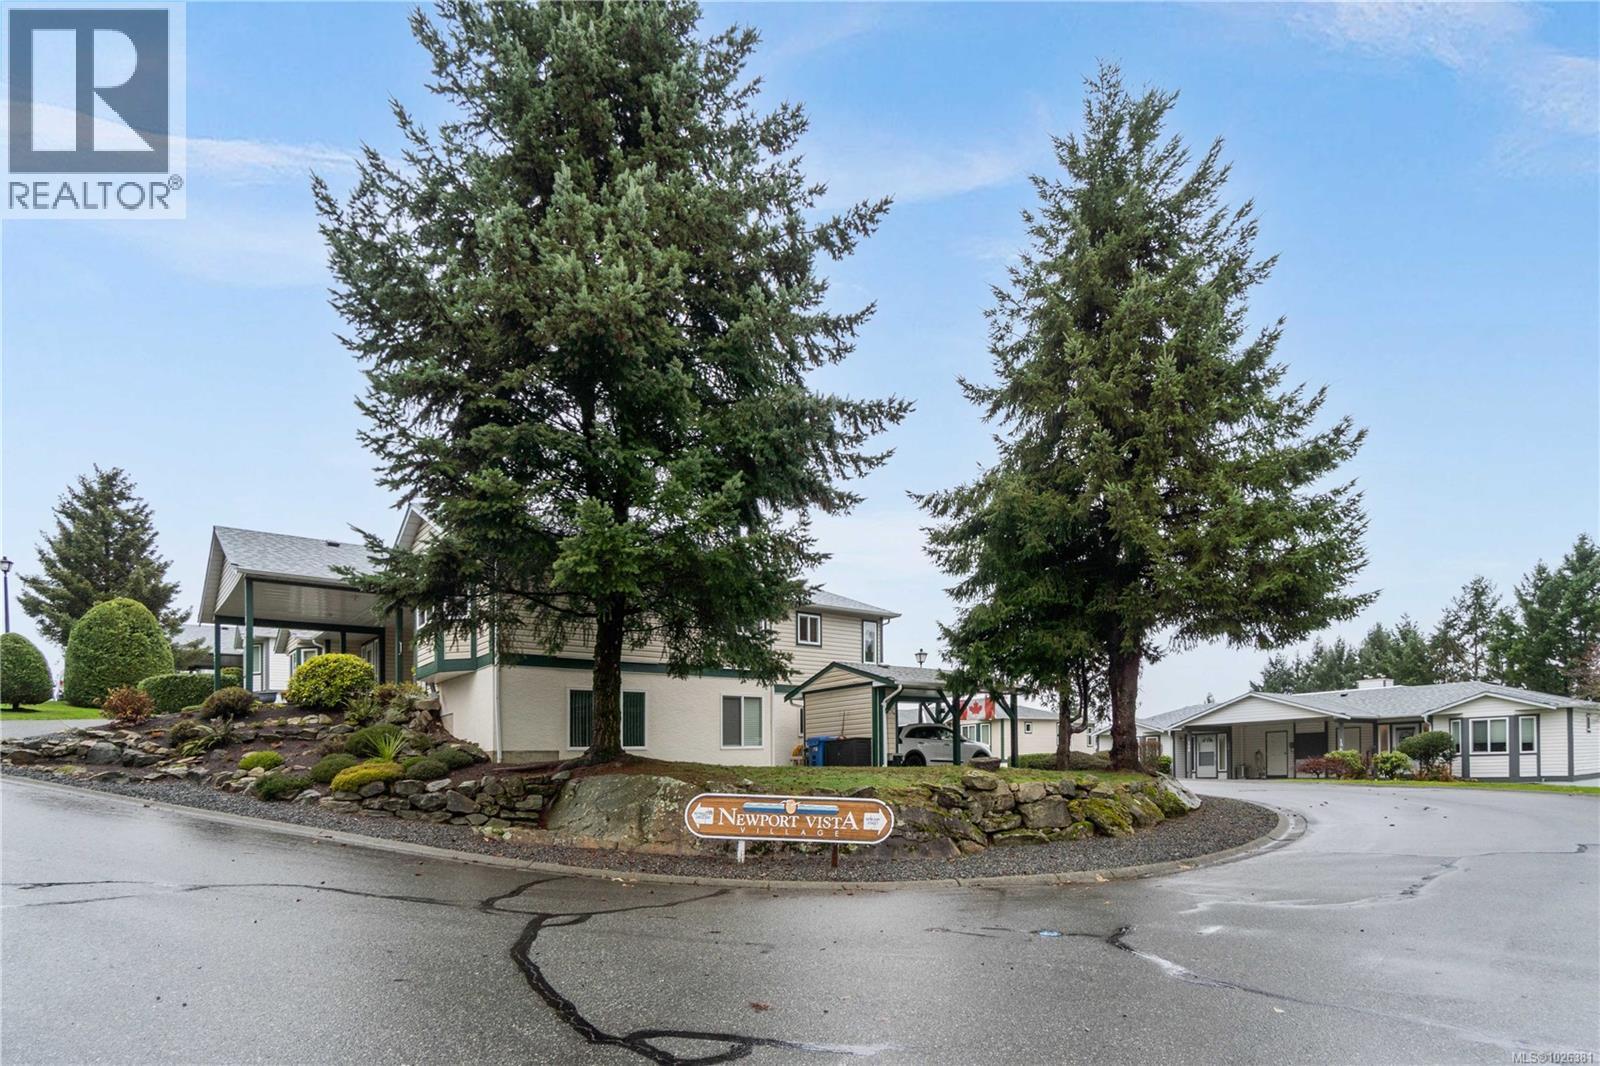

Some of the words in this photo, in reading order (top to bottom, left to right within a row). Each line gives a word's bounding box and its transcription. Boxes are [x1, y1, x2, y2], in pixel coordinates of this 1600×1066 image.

[718, 807, 799, 827] NEWPORT
[805, 811, 858, 830] VISTA
[740, 828, 839, 837] VILLAGE
